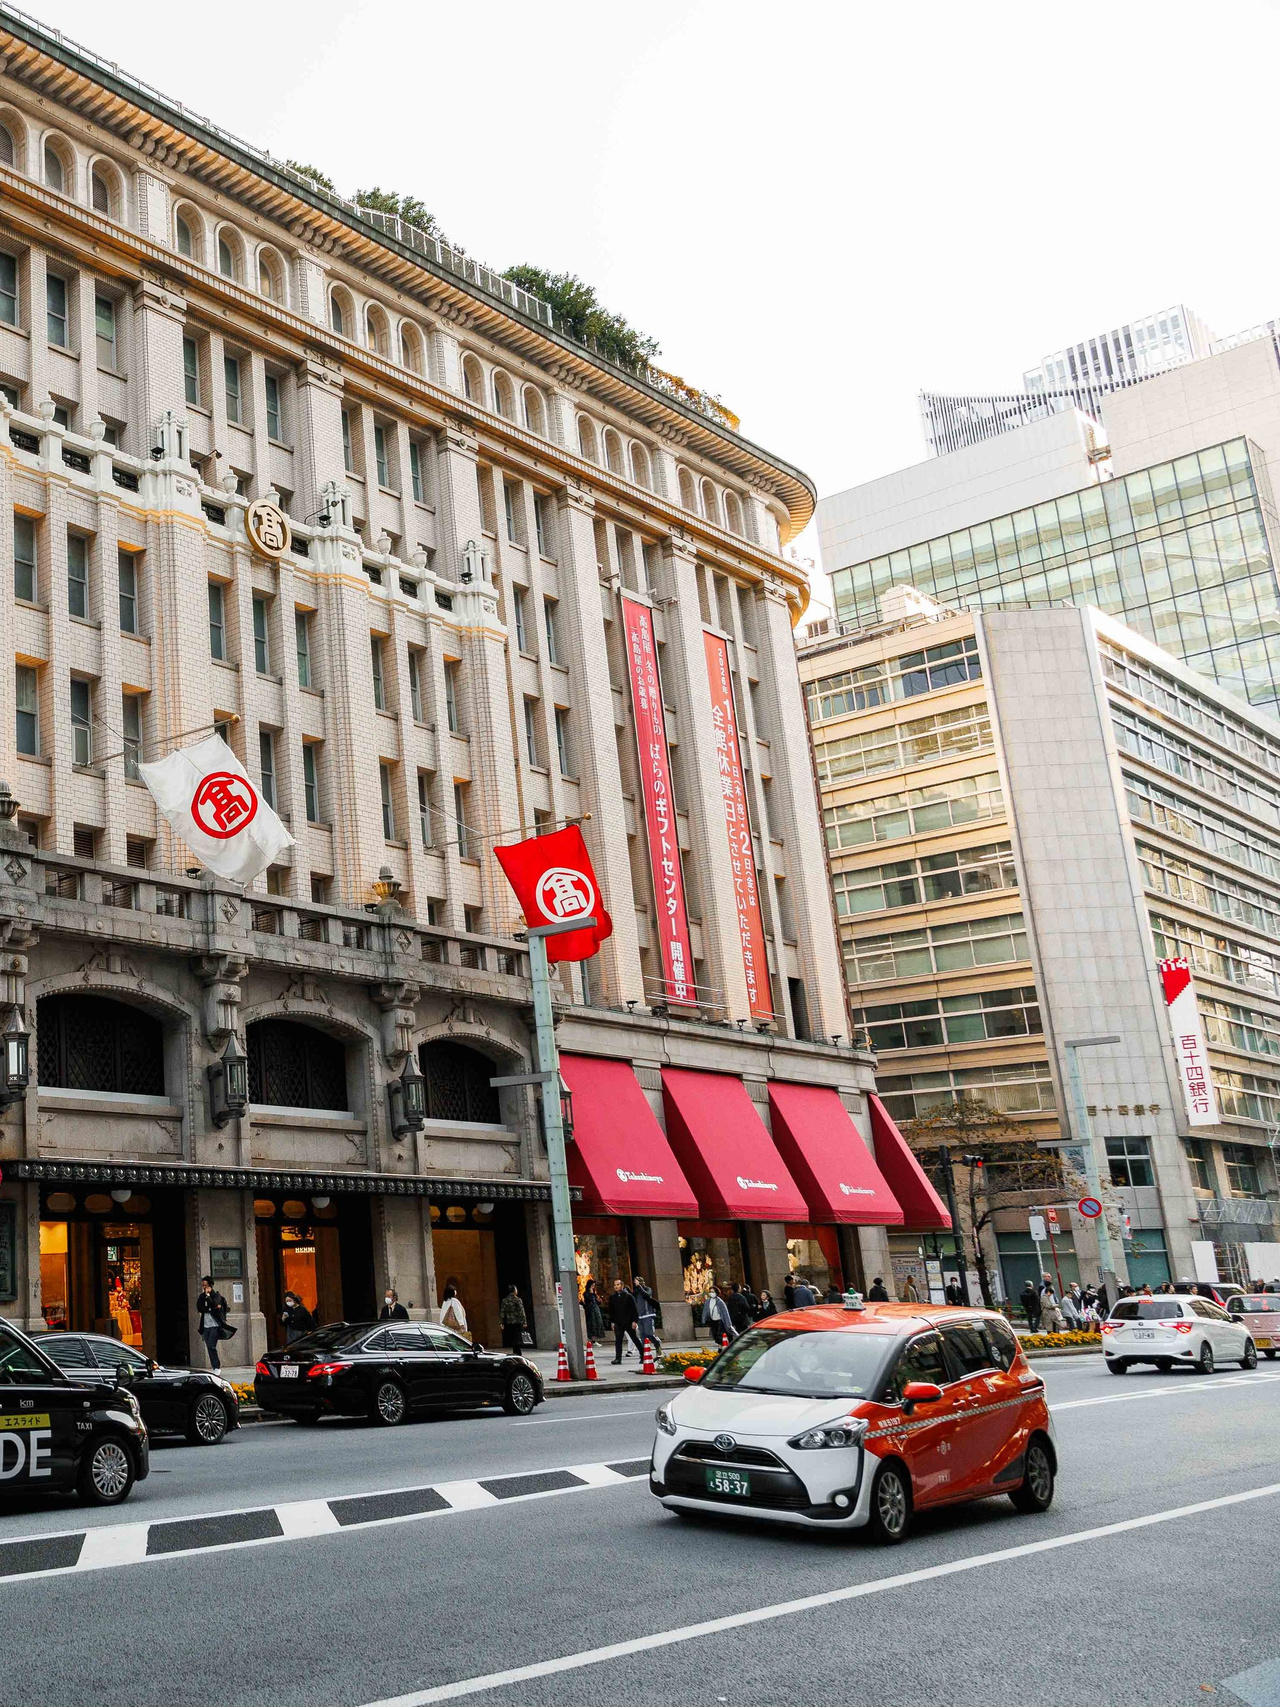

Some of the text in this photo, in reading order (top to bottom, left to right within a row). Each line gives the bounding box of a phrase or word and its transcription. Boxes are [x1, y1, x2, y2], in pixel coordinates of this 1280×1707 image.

[1180, 1034, 1209, 1113] 百十四銀行
[4, 1416, 41, 1427] エスライド
[76, 1421, 93, 1431] TAXI
[728, 1471, 741, 1481] 500
[715, 1478, 748, 1495] 58-37
